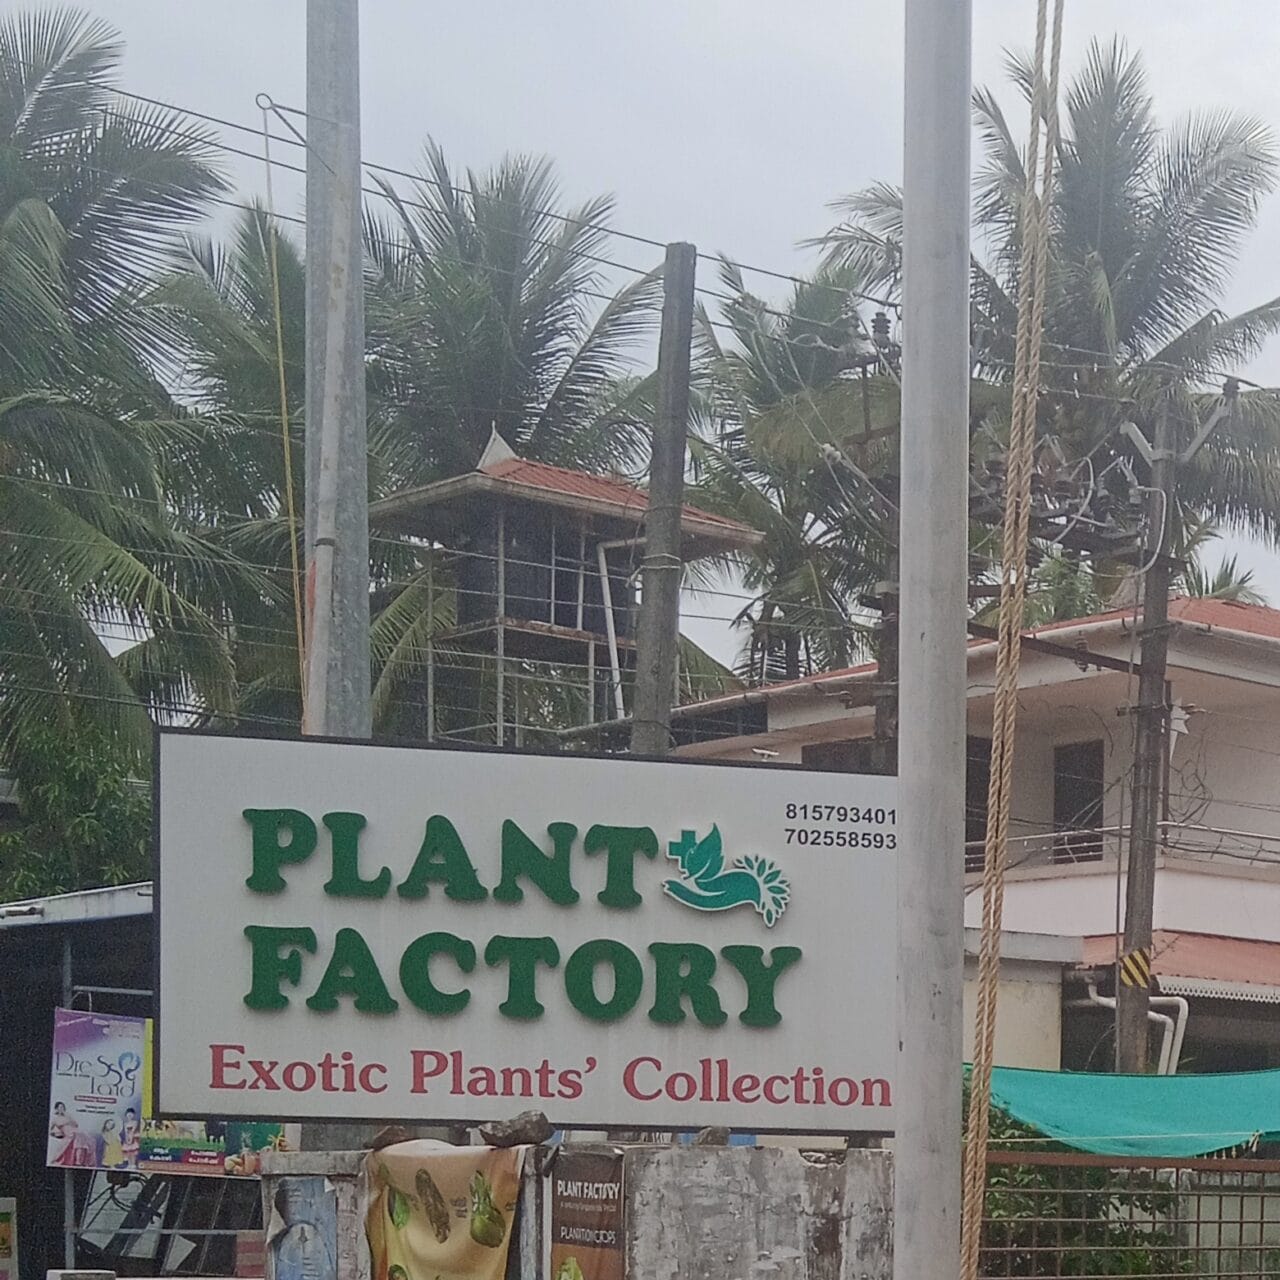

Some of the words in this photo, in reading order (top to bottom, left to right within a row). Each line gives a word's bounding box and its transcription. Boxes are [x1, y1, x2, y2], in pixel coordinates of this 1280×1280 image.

[785, 803, 896, 825] 815793401
[242, 809, 659, 908] PLANT
[784, 828, 897, 850] 702558593
[242, 925, 802, 1028] FACTORY
[208, 1043, 389, 1096] Exotic
[622, 1056, 893, 1107] Collection
[557, 1179, 583, 1198] PLANT
